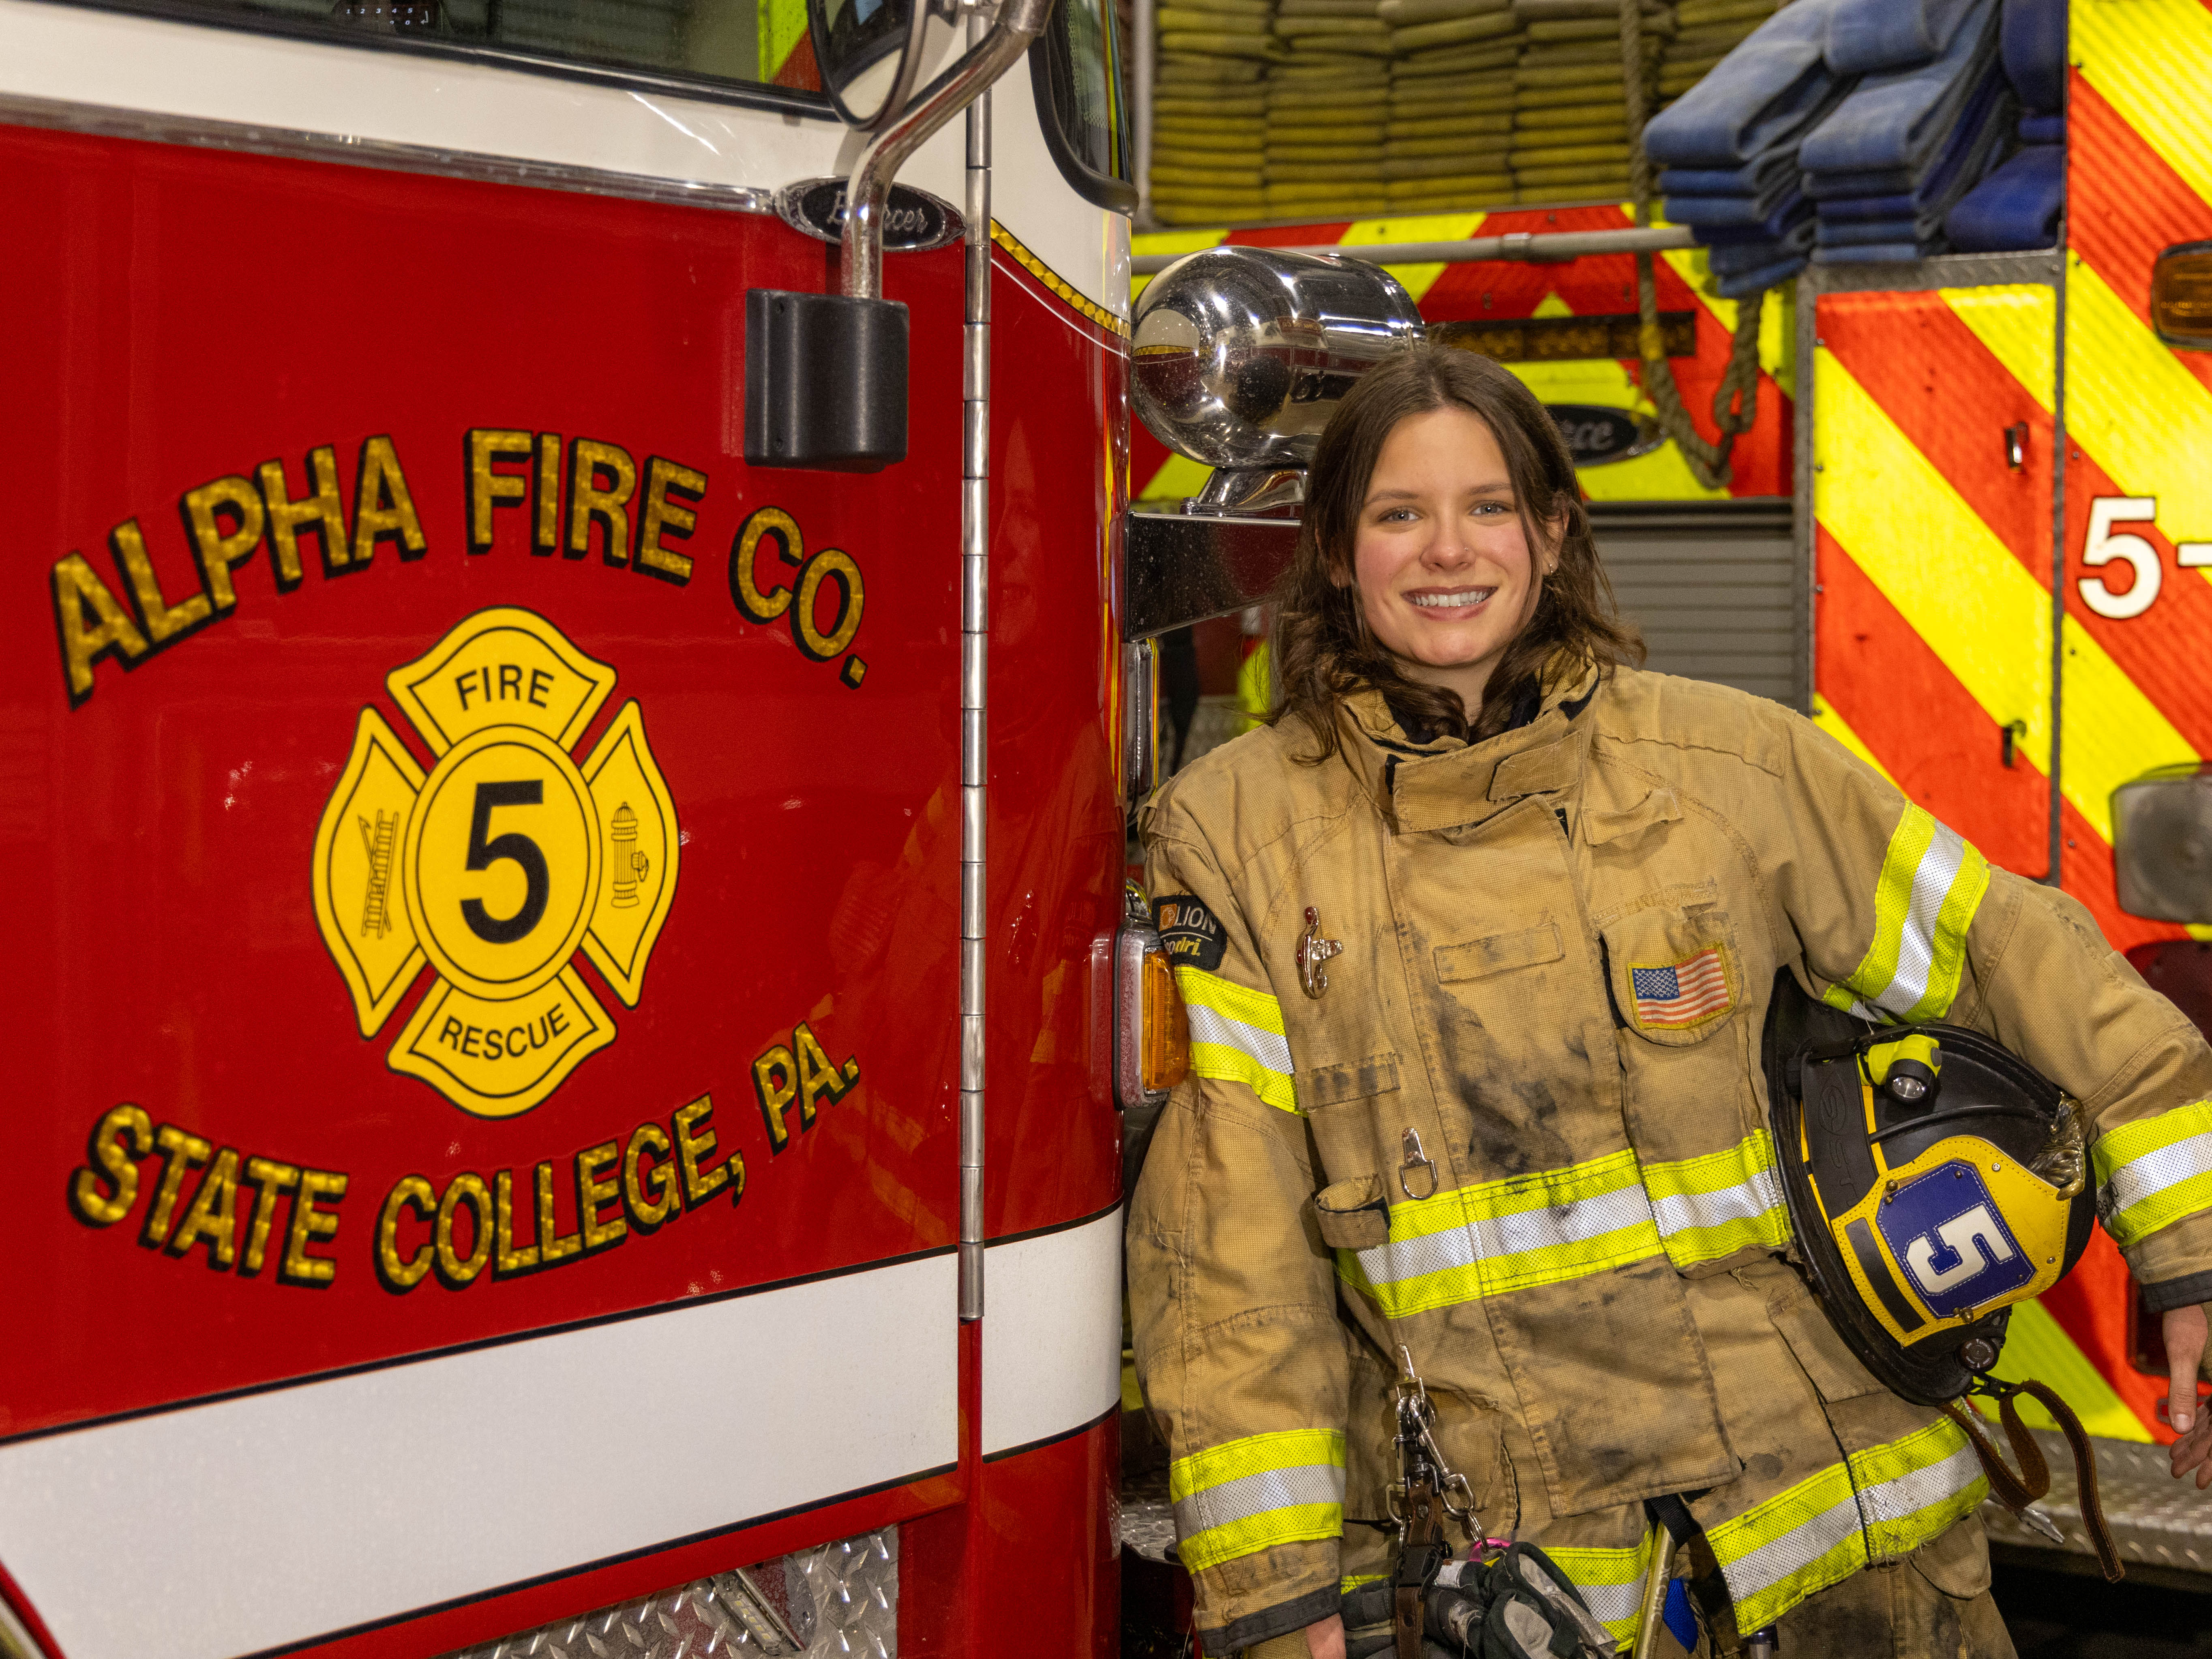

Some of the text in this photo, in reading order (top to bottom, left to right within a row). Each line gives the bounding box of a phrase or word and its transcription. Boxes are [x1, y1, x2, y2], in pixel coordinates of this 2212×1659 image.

[49, 427, 868, 712] ALPHA FIRE CO.
[455, 664, 555, 711] FIRE
[459, 778, 549, 944] 5
[1173, 905, 1216, 935] LION
[438, 1003, 570, 1061] RESCUE
[66, 1020, 860, 1295] STATE COLLEGE, PA.
[1906, 1204, 2015, 1295] 5
